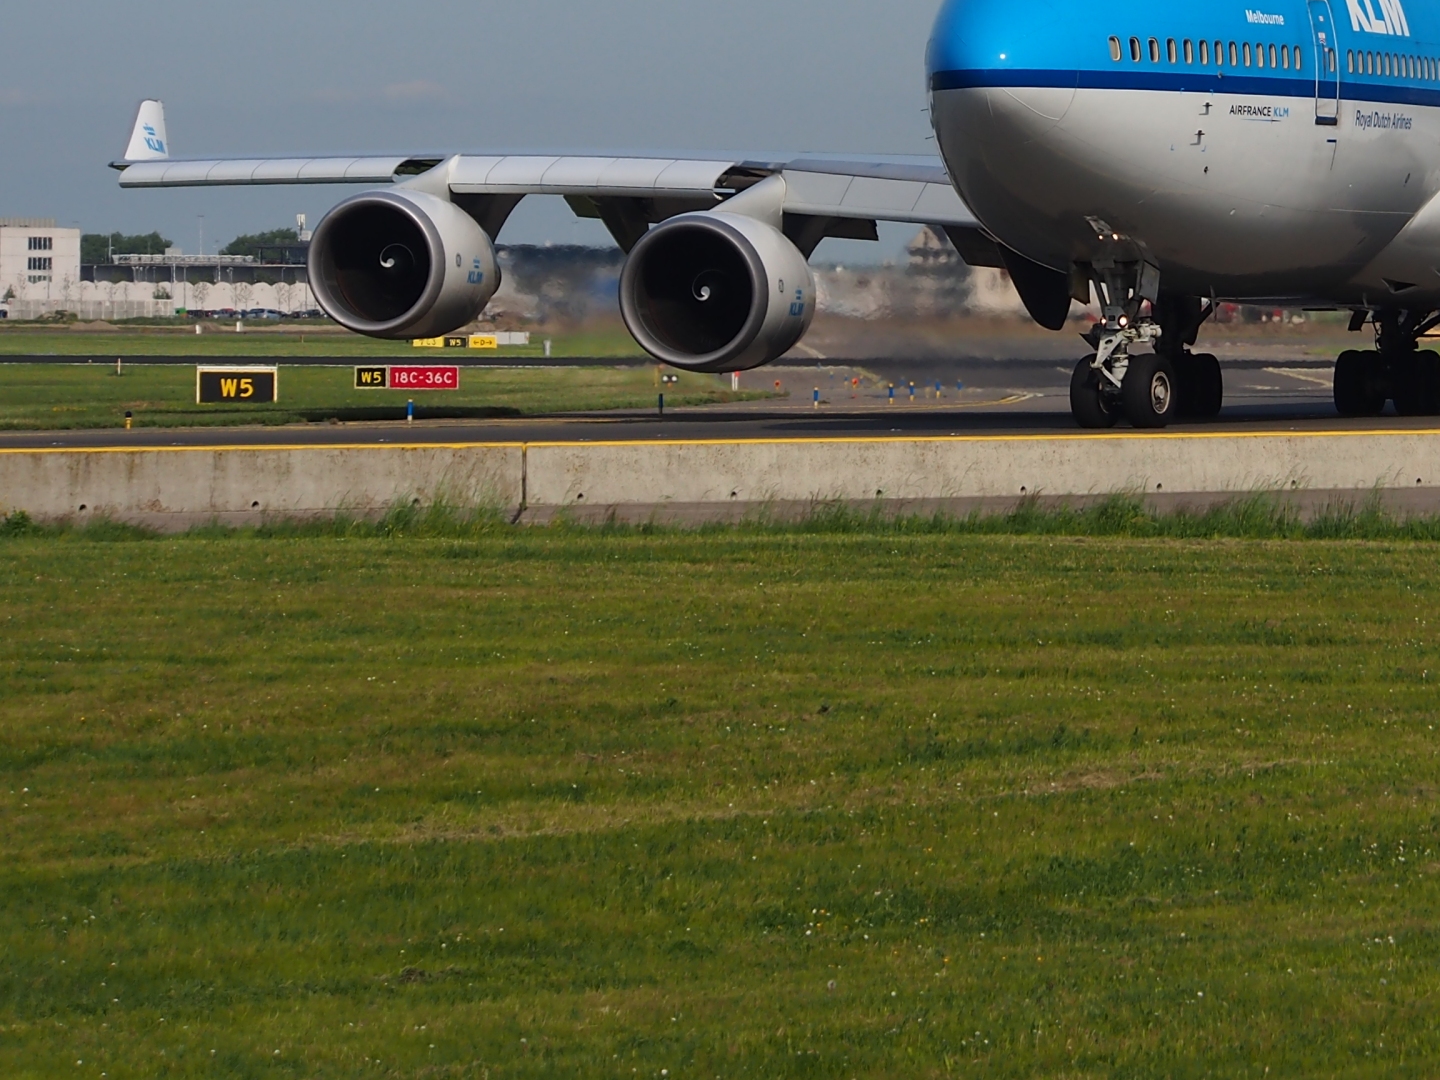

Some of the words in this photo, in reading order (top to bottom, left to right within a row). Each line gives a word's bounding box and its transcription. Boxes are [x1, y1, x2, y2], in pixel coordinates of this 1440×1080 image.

[1245, 9, 1285, 25] Melbourne
[1229, 104, 1272, 117] AIRFRANCE
[1273, 106, 1289, 117] KLM
[1355, 109, 1374, 131] Royal
[1373, 111, 1391, 128] Dutch
[1391, 112, 1412, 130] Airlines
[144, 136, 166, 154] KLM
[361, 371, 382, 383] W5
[394, 371, 453, 384] 18C-36C
[220, 378, 254, 397] W5
